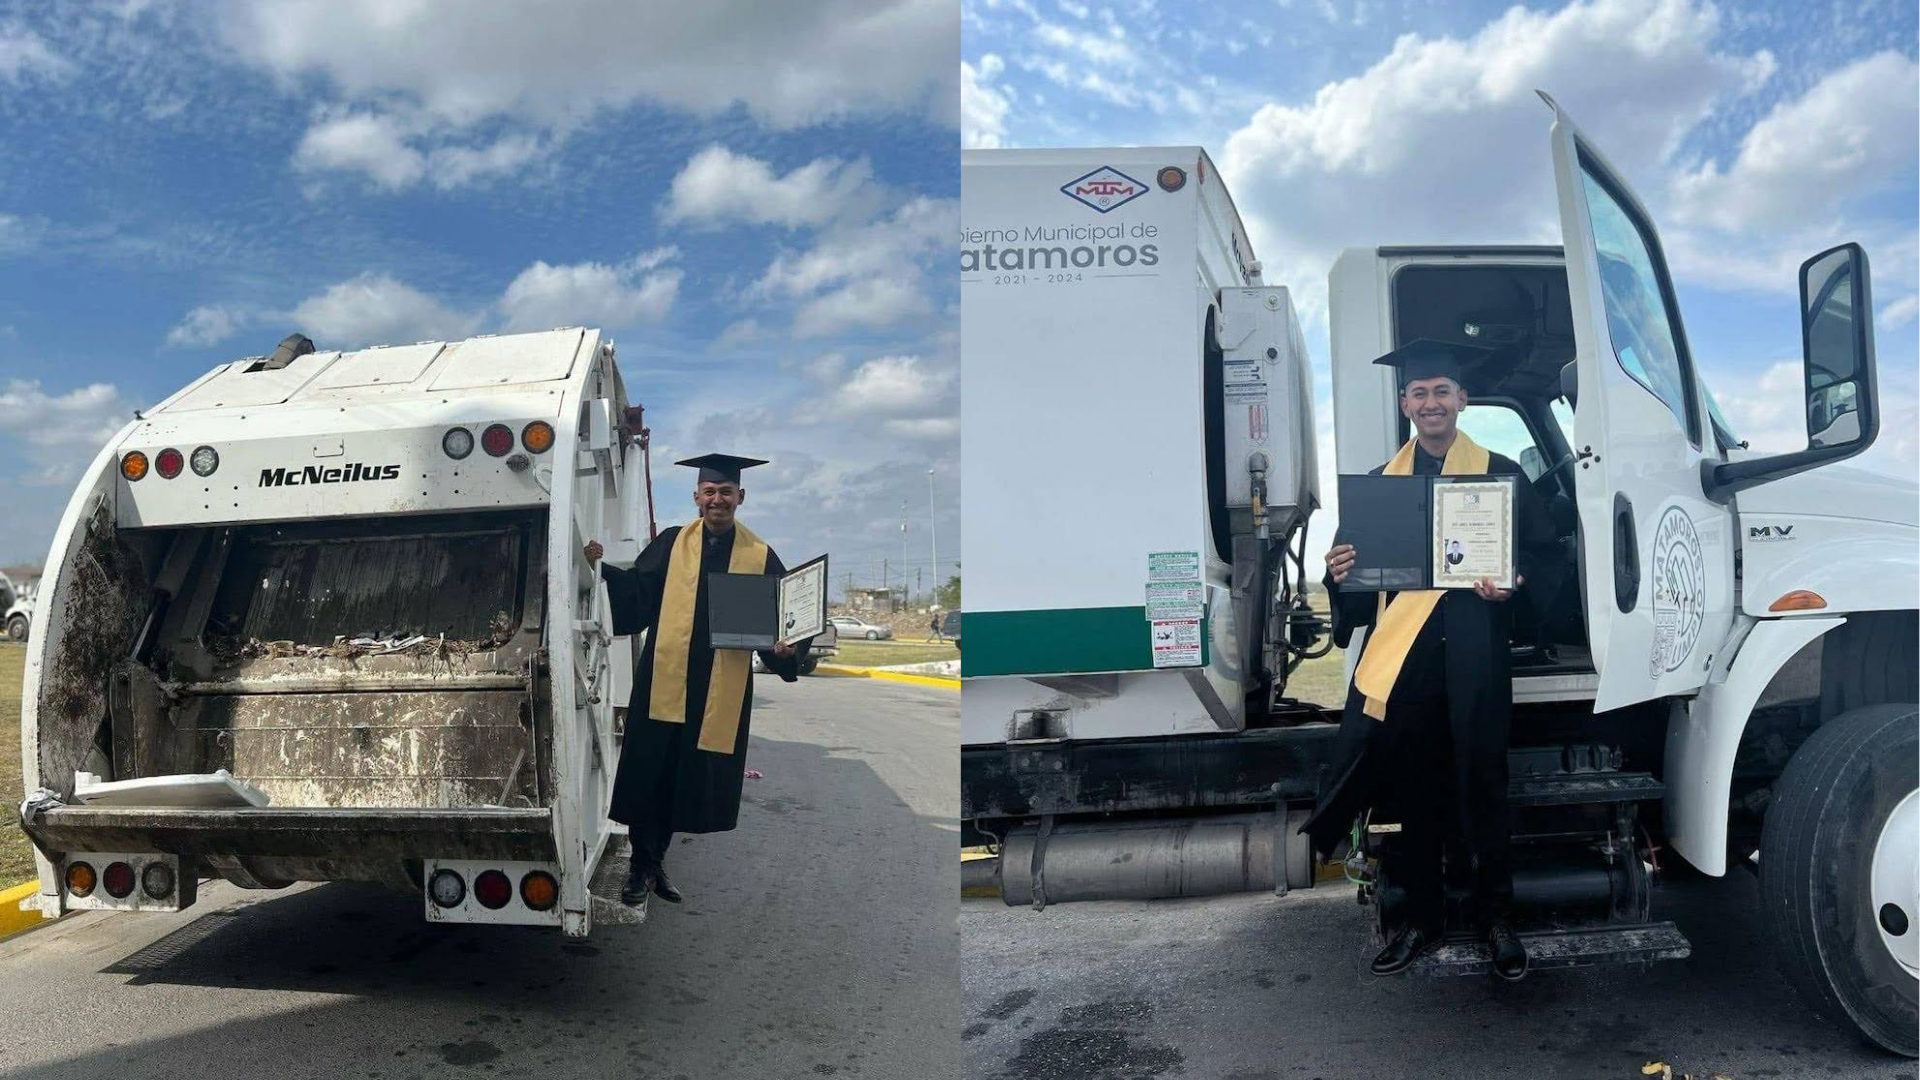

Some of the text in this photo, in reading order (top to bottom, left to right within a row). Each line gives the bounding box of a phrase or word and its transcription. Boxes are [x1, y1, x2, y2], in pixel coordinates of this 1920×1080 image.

[1024, 222, 1125, 244] Municipal
[1130, 222, 1158, 238] de
[995, 275, 1026, 285] 2021
[1048, 273, 1083, 284] 2024
[258, 463, 401, 488] McNeilus
[1655, 514, 1701, 601] MATAMOROS
[1671, 588, 1703, 665] LIMPIO
